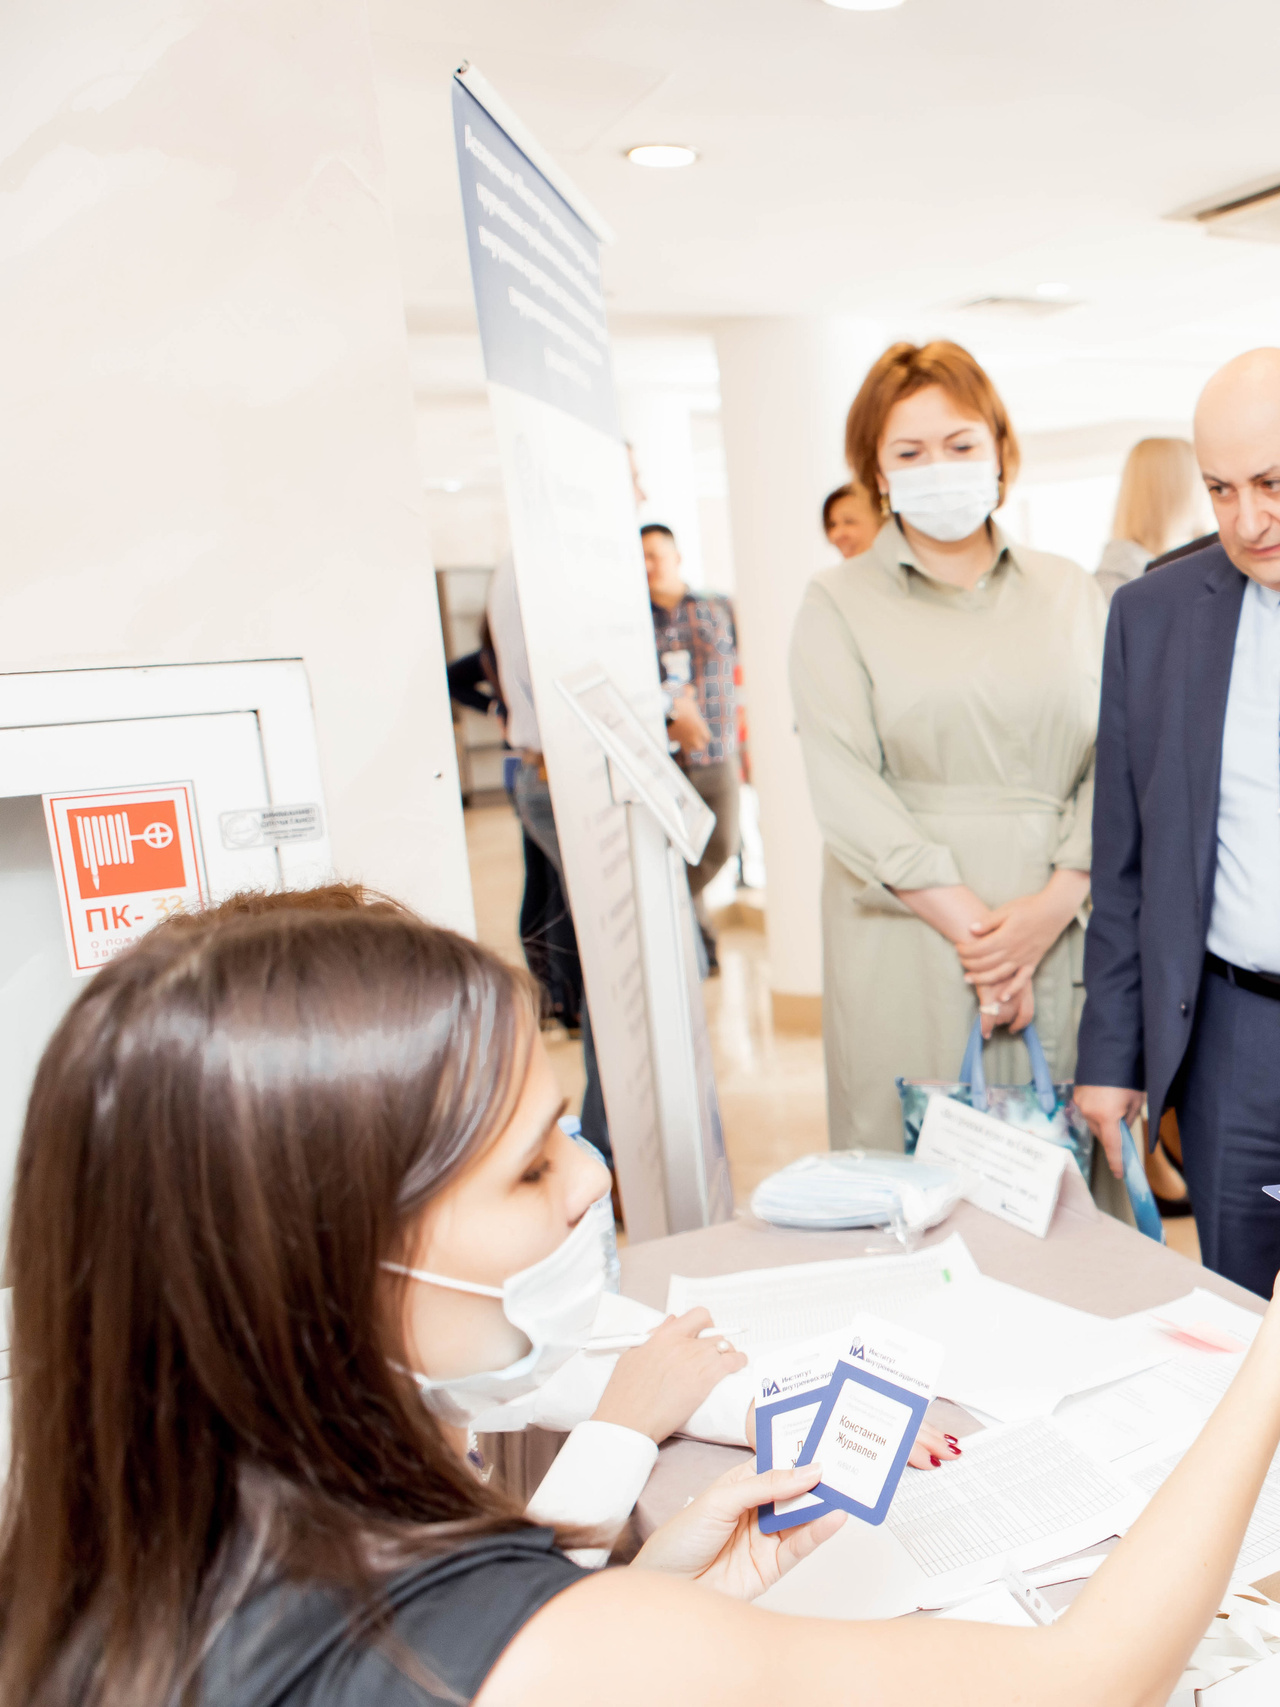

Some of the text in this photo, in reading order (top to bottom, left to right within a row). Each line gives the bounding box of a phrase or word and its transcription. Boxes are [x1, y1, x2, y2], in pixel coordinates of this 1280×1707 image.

[85, 904, 144, 933] ПК-
[868, 1347, 896, 1364] Институт
[781, 1369, 812, 1384] Институт
[782, 1374, 819, 1392] внутренних
[865, 1358, 930, 1390] внутренних аудиторов
[839, 1414, 887, 1447] Константин
[836, 1431, 878, 1461] Журавлев
